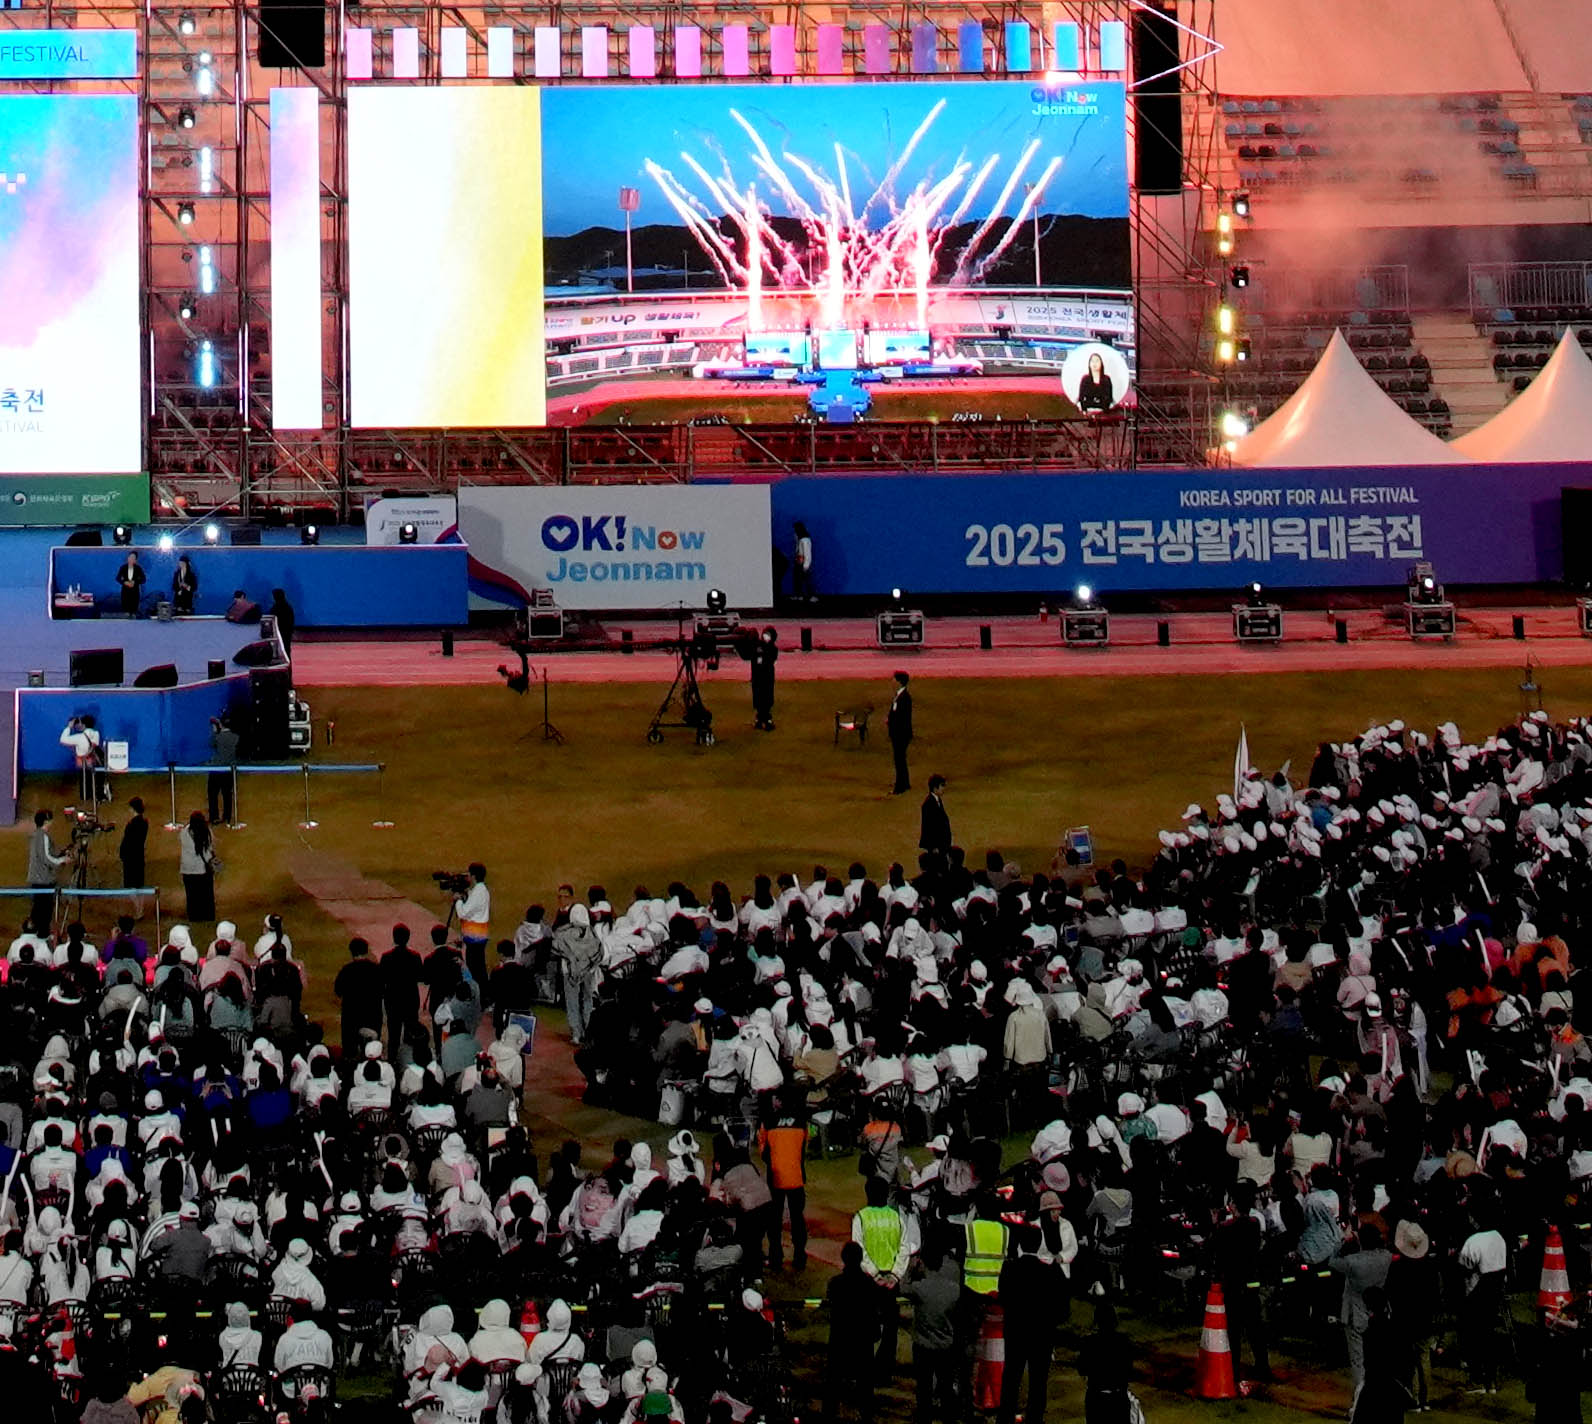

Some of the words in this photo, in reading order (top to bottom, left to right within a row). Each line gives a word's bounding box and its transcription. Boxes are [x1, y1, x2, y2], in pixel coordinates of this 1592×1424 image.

[0, 44, 88, 63] FESTIVAL
[1032, 103, 1098, 116] Jeonnam
[1180, 490, 1229, 507] KOREA
[1234, 489, 1282, 506] SPORT
[1286, 489, 1317, 505] FOR
[1321, 488, 1347, 504] ALL
[1350, 487, 1418, 504] FESTIVAL
[541, 514, 627, 551] OK!
[965, 523, 1066, 566] 2025
[1080, 514, 1423, 564] 전국생활체육대축전
[546, 556, 706, 581] Jeonnam
